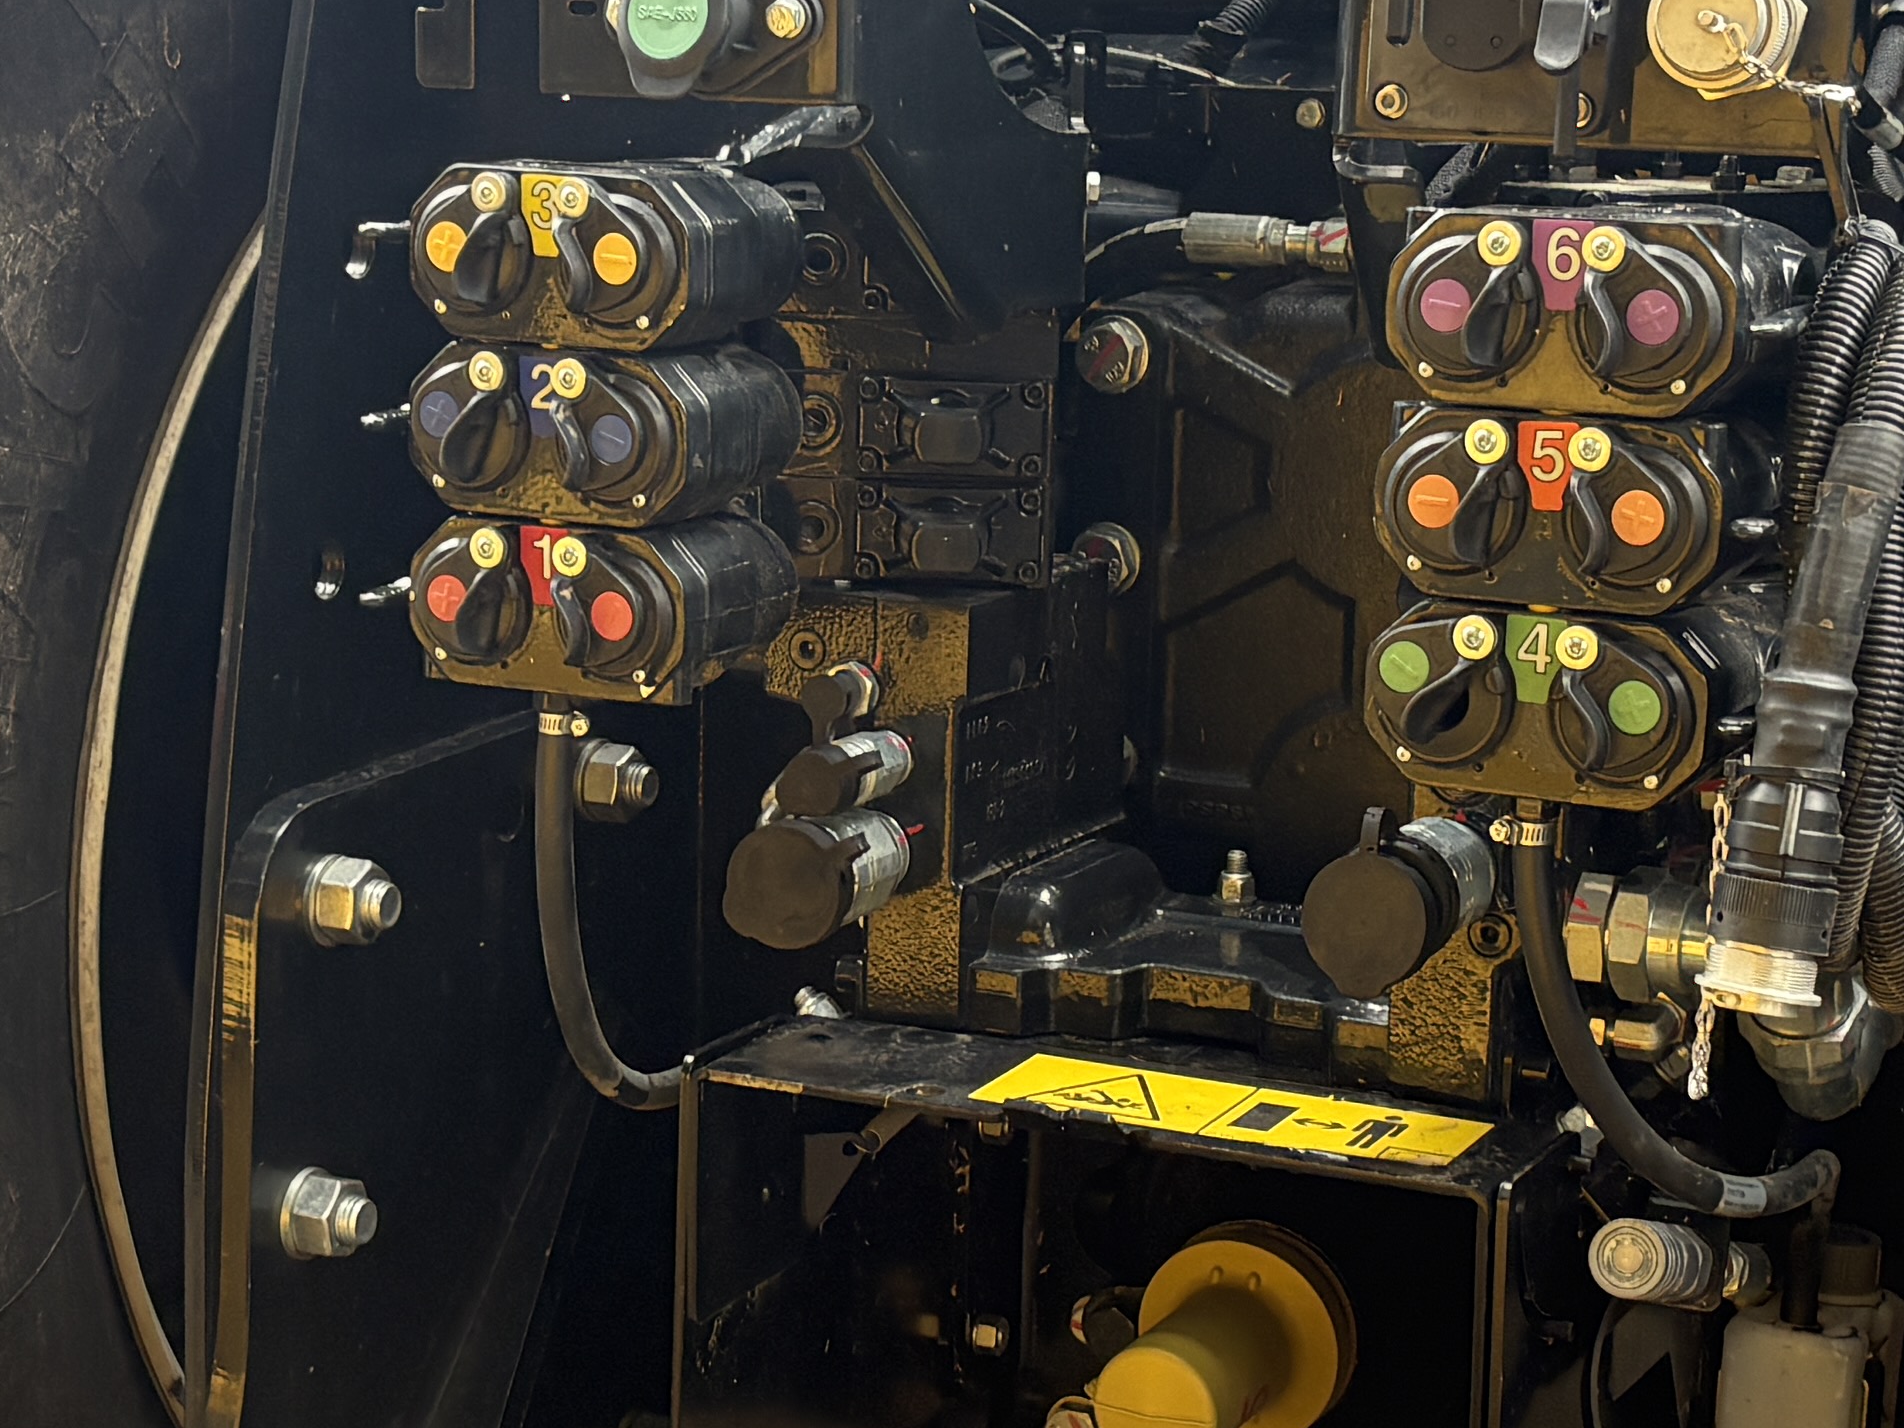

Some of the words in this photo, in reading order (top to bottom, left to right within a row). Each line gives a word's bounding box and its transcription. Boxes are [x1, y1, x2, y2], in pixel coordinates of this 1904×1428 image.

[532, 181, 558, 229] 3
[1546, 226, 1582, 281] 6
[531, 363, 554, 410] 2
[1529, 428, 1566, 484] 5
[533, 533, 552, 581] 1
[1516, 621, 1553, 676] 4
